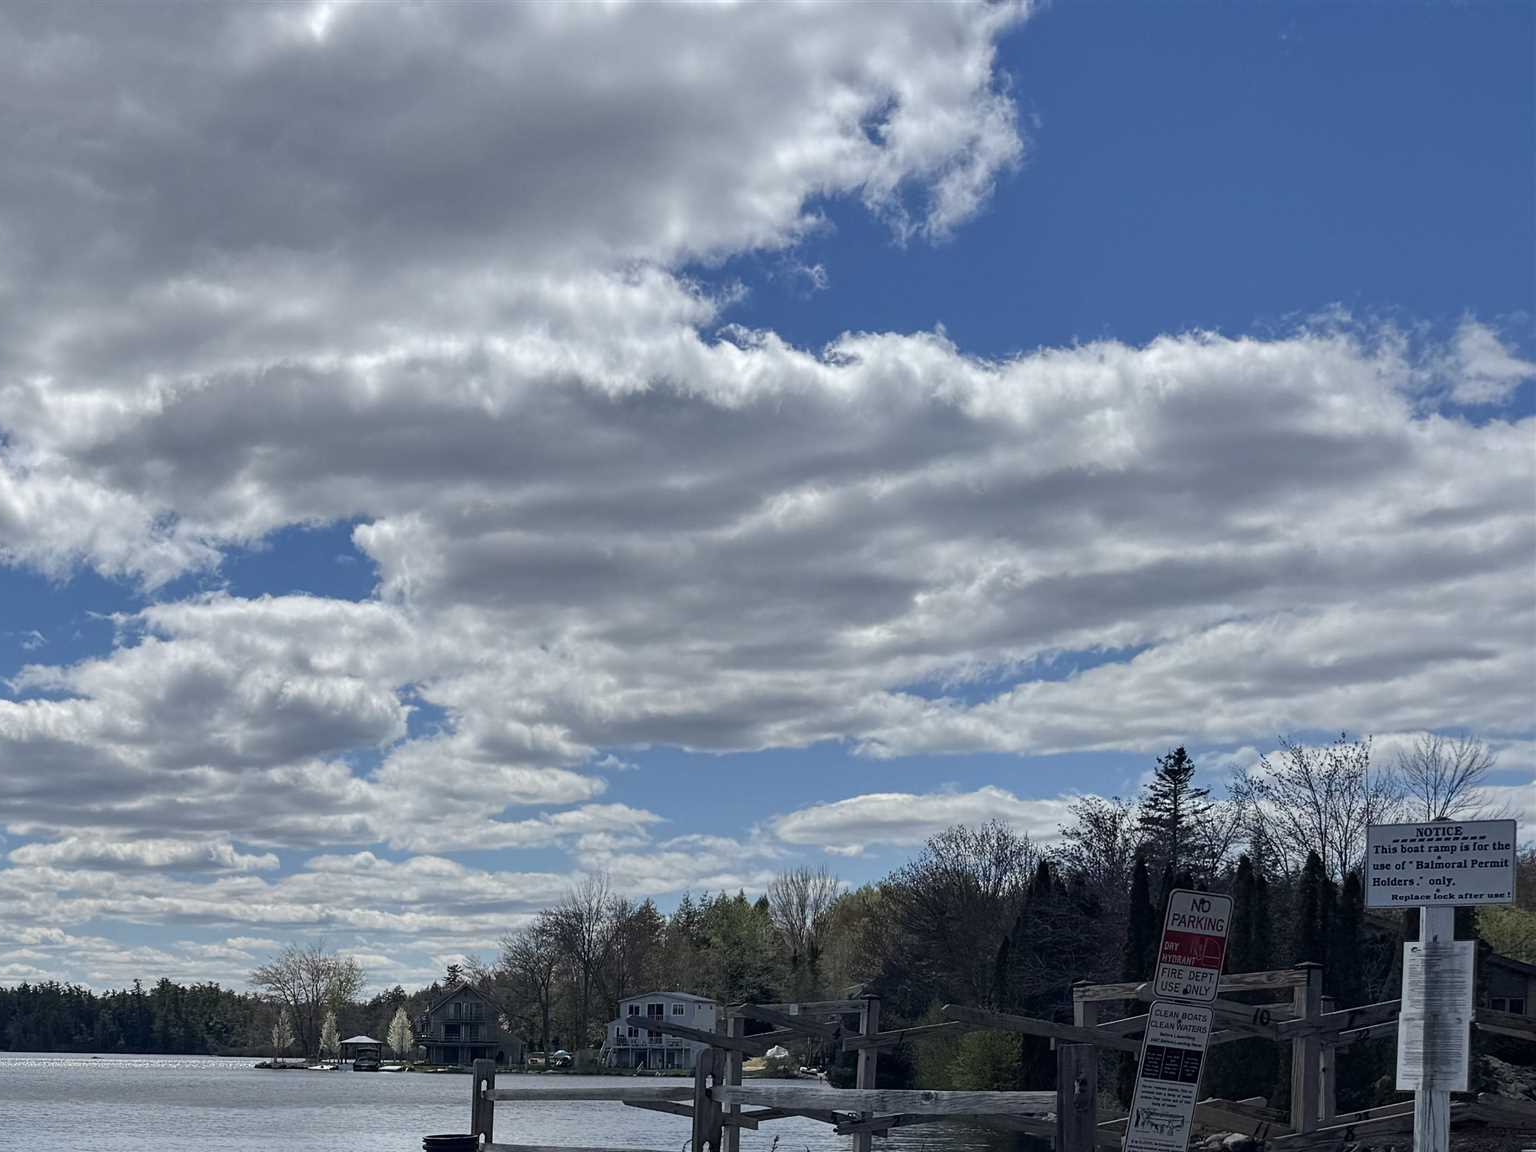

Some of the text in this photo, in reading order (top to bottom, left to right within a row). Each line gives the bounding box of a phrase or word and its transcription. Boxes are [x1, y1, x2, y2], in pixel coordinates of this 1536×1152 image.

[1416, 826, 1463, 837] NOTICE
[1373, 841, 1511, 854] This boat ramp is for the
[1373, 862, 1391, 870] use
[1395, 861, 1407, 870] of
[1471, 859, 1509, 868] Permit
[1429, 876, 1456, 887] only.
[1392, 894, 1431, 902] Replace
[1458, 892, 1484, 900] after
[1190, 898, 1211, 913] NO
[1171, 913, 1224, 932] PARKING
[1163, 941, 1180, 951] DRY
[1161, 968, 1214, 983] FIRE DEPT
[1161, 982, 1210, 996] USE ONLY
[1155, 1009, 1179, 1019] CLEAN
[1253, 1007, 1270, 1025] 10
[1151, 1020, 1207, 1034] CLEAN WATERS
